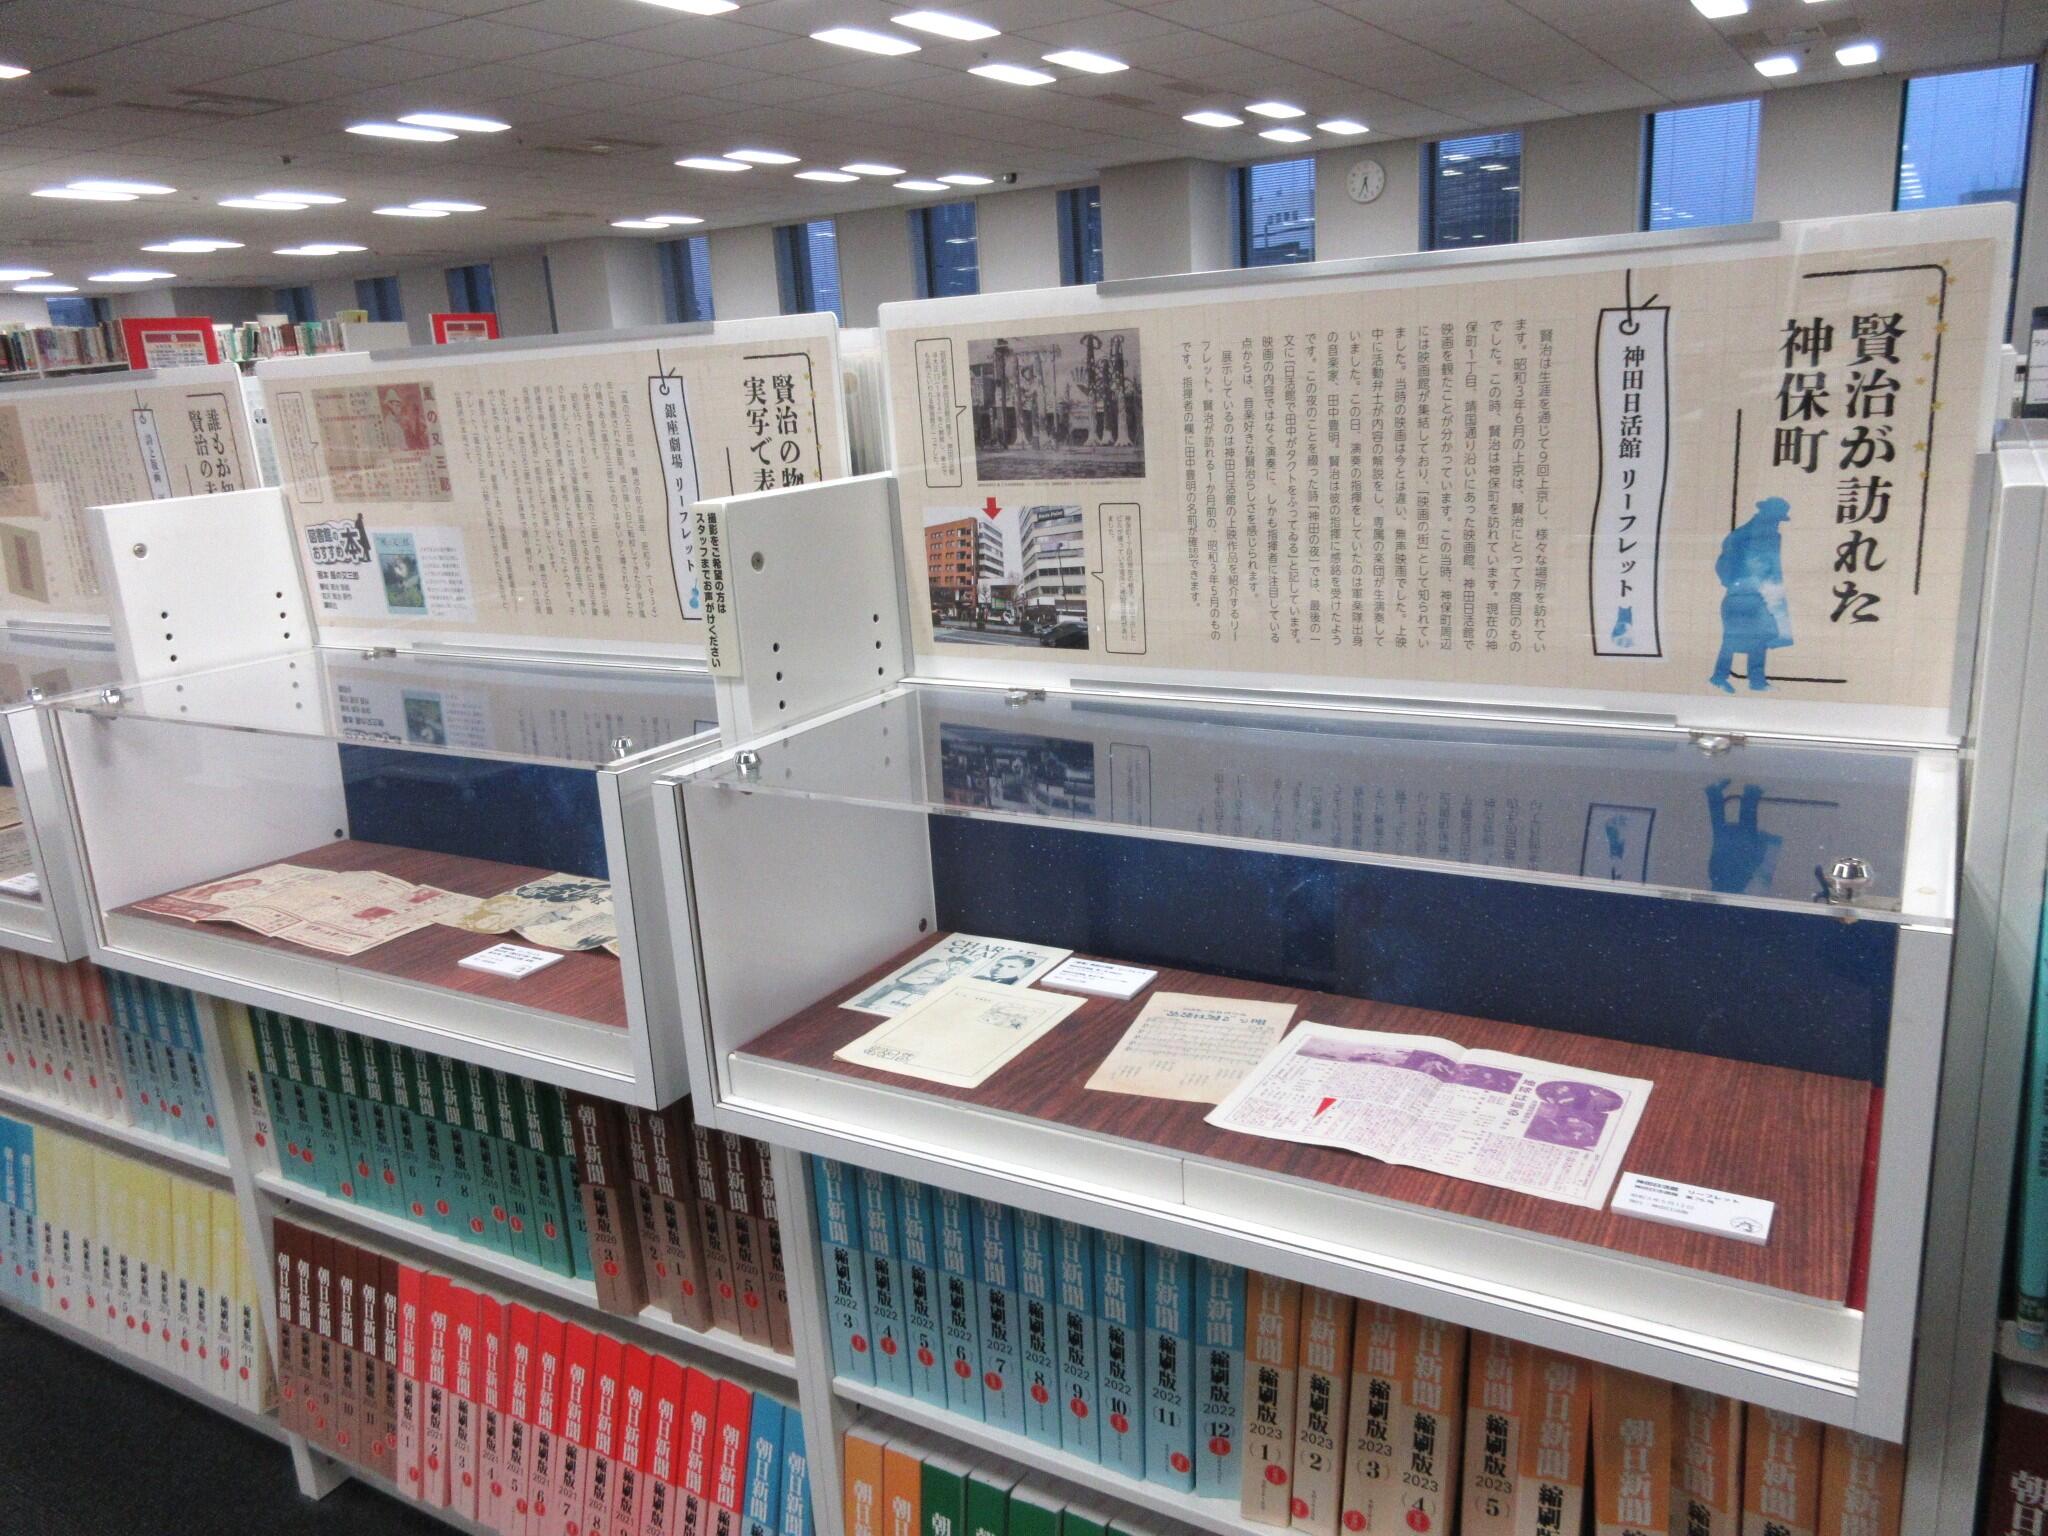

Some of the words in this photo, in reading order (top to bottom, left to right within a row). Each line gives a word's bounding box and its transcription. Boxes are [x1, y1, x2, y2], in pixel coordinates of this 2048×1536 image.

[1617, 345, 1646, 460] 神田日活館
[1771, 316, 1835, 474] 神保町
[1830, 311, 1907, 625] 賢治が訪れた
[341, 527, 360, 558] 本
[675, 476, 696, 573] リーフレット
[1617, 468, 1638, 598] リーフレット
[695, 512, 721, 668] スタッフまでお声がけください
[707, 512, 726, 614] 撮影をご希望の方は
[822, 1159, 848, 1244] 朝日新聞
[864, 1169, 889, 1255] 朝日新聞
[904, 1179, 926, 1264] 朝日新聞
[834, 1247, 852, 1298] 縮刷版
[981, 1198, 1006, 1287] 朝日新聞
[1020, 1209, 1044, 1297] 朝日新聞
[1060, 1220, 1084, 1311] 朝日新聞
[1103, 1229, 1127, 1325] 朝日新聞
[278, 1252, 291, 1321] 朝日新聞
[298, 1259, 311, 1329] 朝日新聞
[318, 1266, 331, 1337] 朝日新聞
[341, 1275, 354, 1347] 朝日新聞
[834, 1296, 858, 1310] 2022
[874, 1257, 892, 1308] 縮刷版
[874, 1306, 897, 1320] 2022
[912, 1265, 929, 1318] 縮刷版
[949, 1276, 967, 1330] 縮刷版
[989, 1288, 1008, 1342] 縮刷版
[1207, 1257, 1233, 1346] 朝日新聞
[363, 1283, 376, 1356] 朝日新聞
[384, 1292, 397, 1366] 朝日新聞
[403, 1302, 415, 1377] 朝日新聞
[430, 1311, 447, 1386] 朝日新聞
[911, 1314, 934, 1330] 2022
[947, 1326, 972, 1341] 2022
[987, 1339, 1012, 1355] 2022
[1028, 1299, 1046, 1354] 縮刷版
[1067, 1311, 1085, 1367] 縮刷版
[1108, 1325, 1127, 1382] 縮刷版
[457, 1323, 472, 1399] 朝日新聞
[486, 1332, 498, 1409] 朝日新聞
[512, 1341, 528, 1420] 朝日新聞
[538, 1352, 556, 1430] 朝日新聞
[1025, 1351, 1052, 1368] 2022
[1064, 1363, 1090, 1382] 2022
[1104, 1379, 1132, 1396] 2022
[1158, 1334, 1177, 1392] 縮刷版
[1210, 1350, 1230, 1404] 縮刷版
[566, 1363, 585, 1443] 朝日新聞
[596, 1375, 615, 1455] 朝日新聞
[623, 1385, 643, 1468] 朝日新聞
[1152, 1388, 1182, 1406] 2022
[1203, 1403, 1236, 1417] 2022
[1257, 1366, 1279, 1425] 縮刷版
[1308, 1373, 1330, 1435] 縮刷版
[1366, 1378, 1391, 1441] 縮刷版
[1536, 1362, 1577, 1480] 朝日新聞
[653, 1397, 674, 1481] 朝日新聞
[686, 1410, 707, 1494] 朝日新聞
[718, 1423, 740, 1508] 朝日新聞
[1249, 1424, 1282, 1440] 2023
[1300, 1430, 1333, 1450] 2023
[1358, 1439, 1392, 1457] 2023
[1411, 1412, 1436, 1477] 縮刷版
[1484, 1413, 1508, 1478] 縮刷版
[751, 1436, 774, 1523] 朝日新聞
[1402, 1472, 1438, 1493] 2023
[1475, 1475, 1512, 1494] 2023
[1617, 1418, 1655, 1525] 朝日新聞
